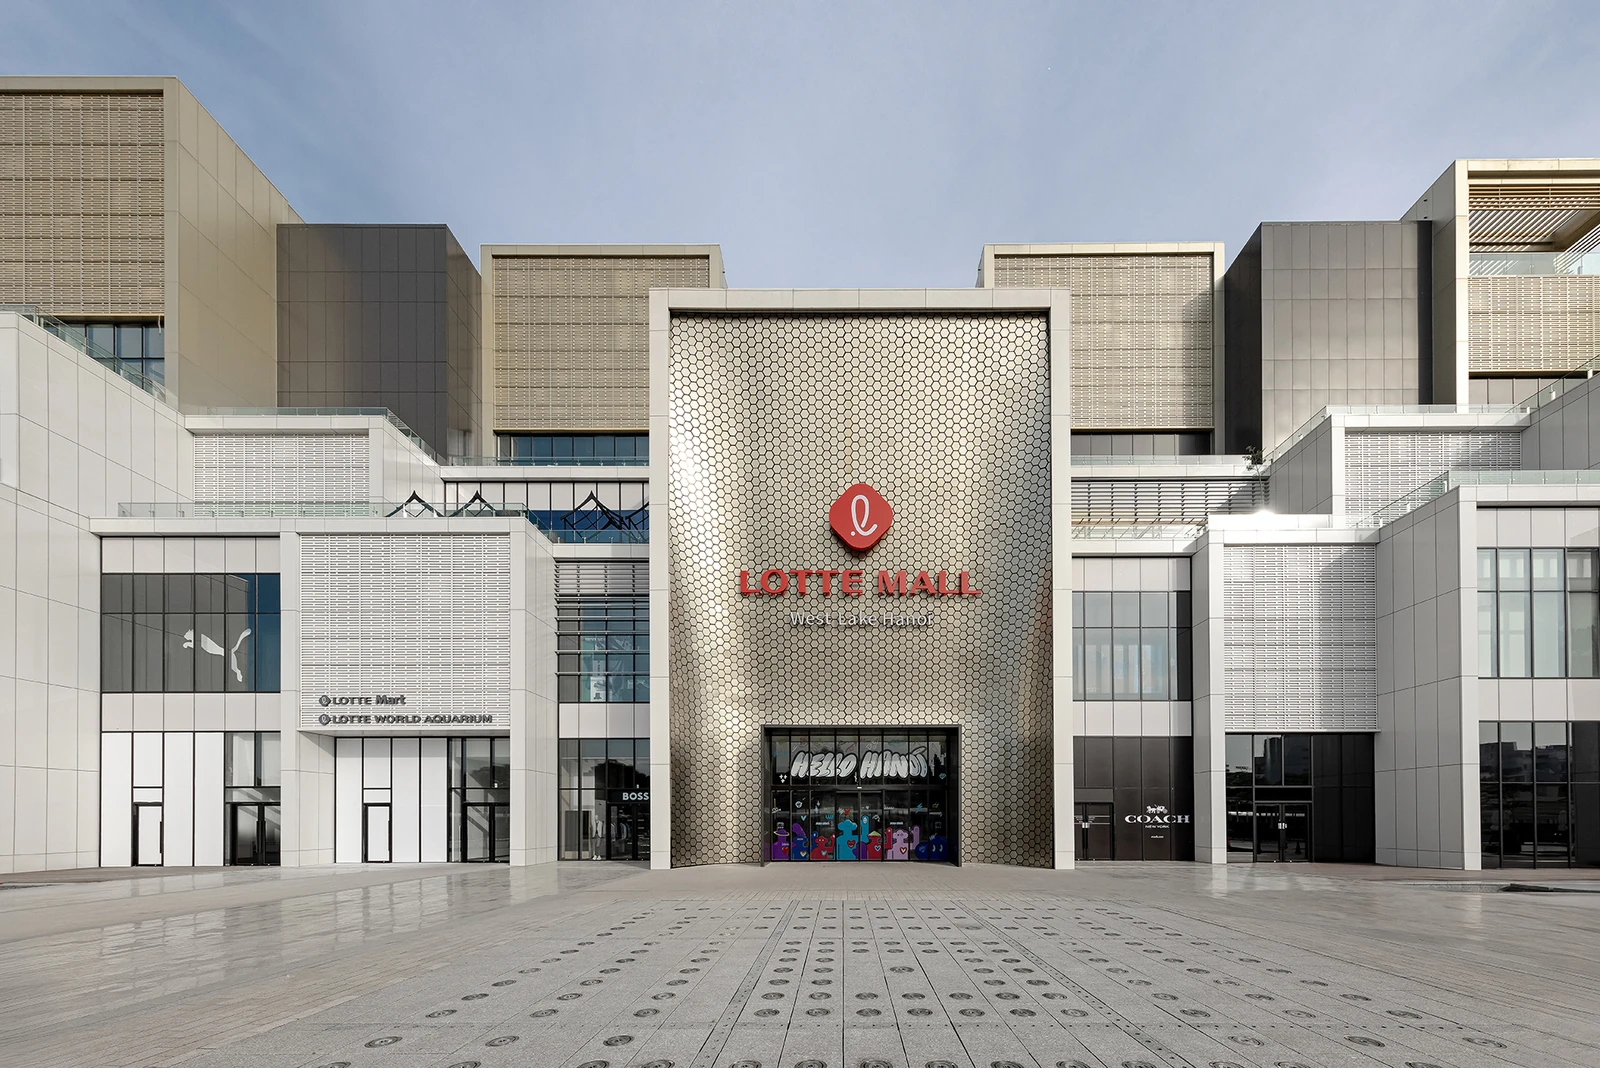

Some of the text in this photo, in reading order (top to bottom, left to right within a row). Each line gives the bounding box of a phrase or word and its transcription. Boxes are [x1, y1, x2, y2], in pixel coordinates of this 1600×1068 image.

[740, 569, 982, 597] LOTTE MALL
[790, 610, 934, 627] West Lake Hanoi
[332, 694, 407, 706] LOTTE Mart
[332, 714, 493, 725] LOTTE WORLD AQUARIUM
[790, 751, 858, 778] HELLO
[622, 791, 650, 801] BOSS
[1124, 815, 1190, 823] COACH
